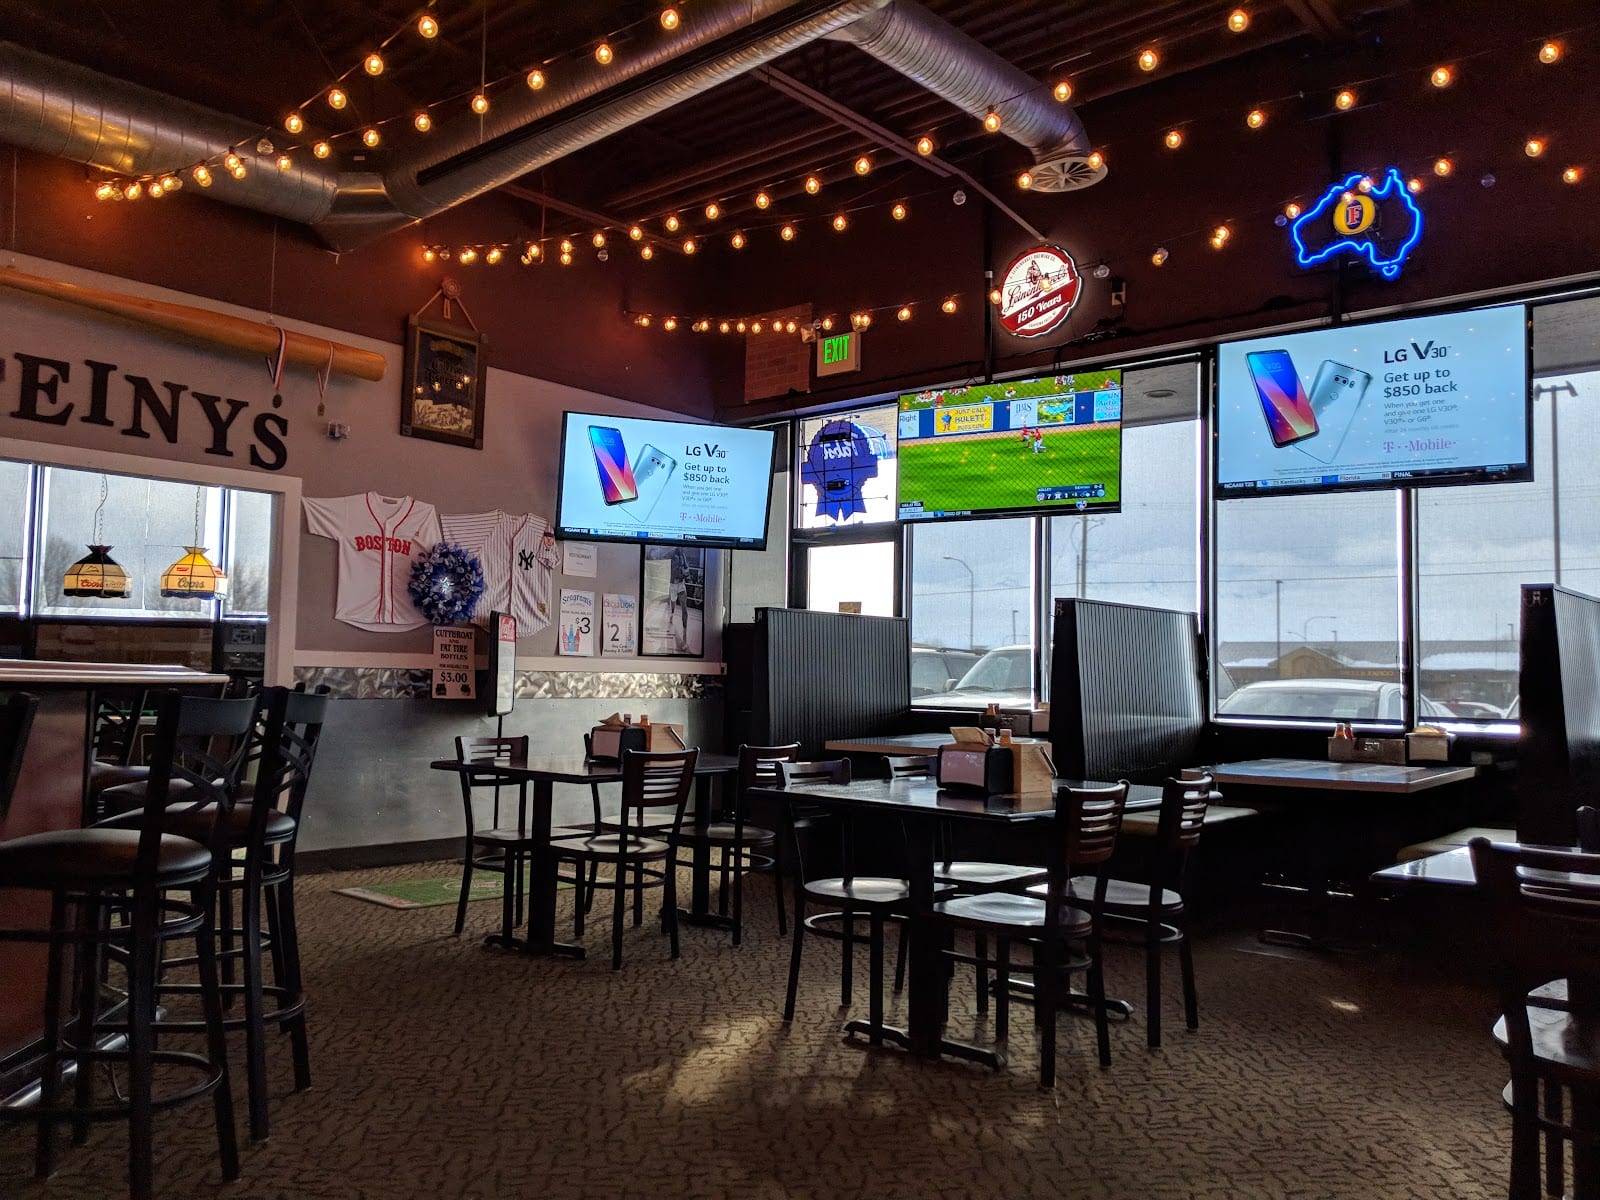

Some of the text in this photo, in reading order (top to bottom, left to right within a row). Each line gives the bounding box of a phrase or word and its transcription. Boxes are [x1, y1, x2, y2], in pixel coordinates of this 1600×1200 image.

[1347, 205, 1362, 226] F
[1017, 307, 1035, 324] 150
[1036, 294, 1062, 313] Years
[824, 335, 850, 364] EXIT
[1384, 349, 1408, 364] LG
[1384, 369, 1450, 383] Get up to
[1384, 381, 1458, 399] $850 back
[0, 352, 289, 471] EINYS
[899, 414, 917, 424] Right
[685, 445, 701, 457] LG
[684, 462, 701, 471] Get
[703, 465, 714, 474] up
[683, 472, 730, 484] $850 back
[355, 535, 412, 556] BOSTON
[80, 578, 104, 588] Coors
[177, 577, 205, 589] Coors
[435, 629, 473, 639] CUTTHROAT
[440, 644, 468, 653] FAT TIRE
[440, 672, 468, 683] $3.00
